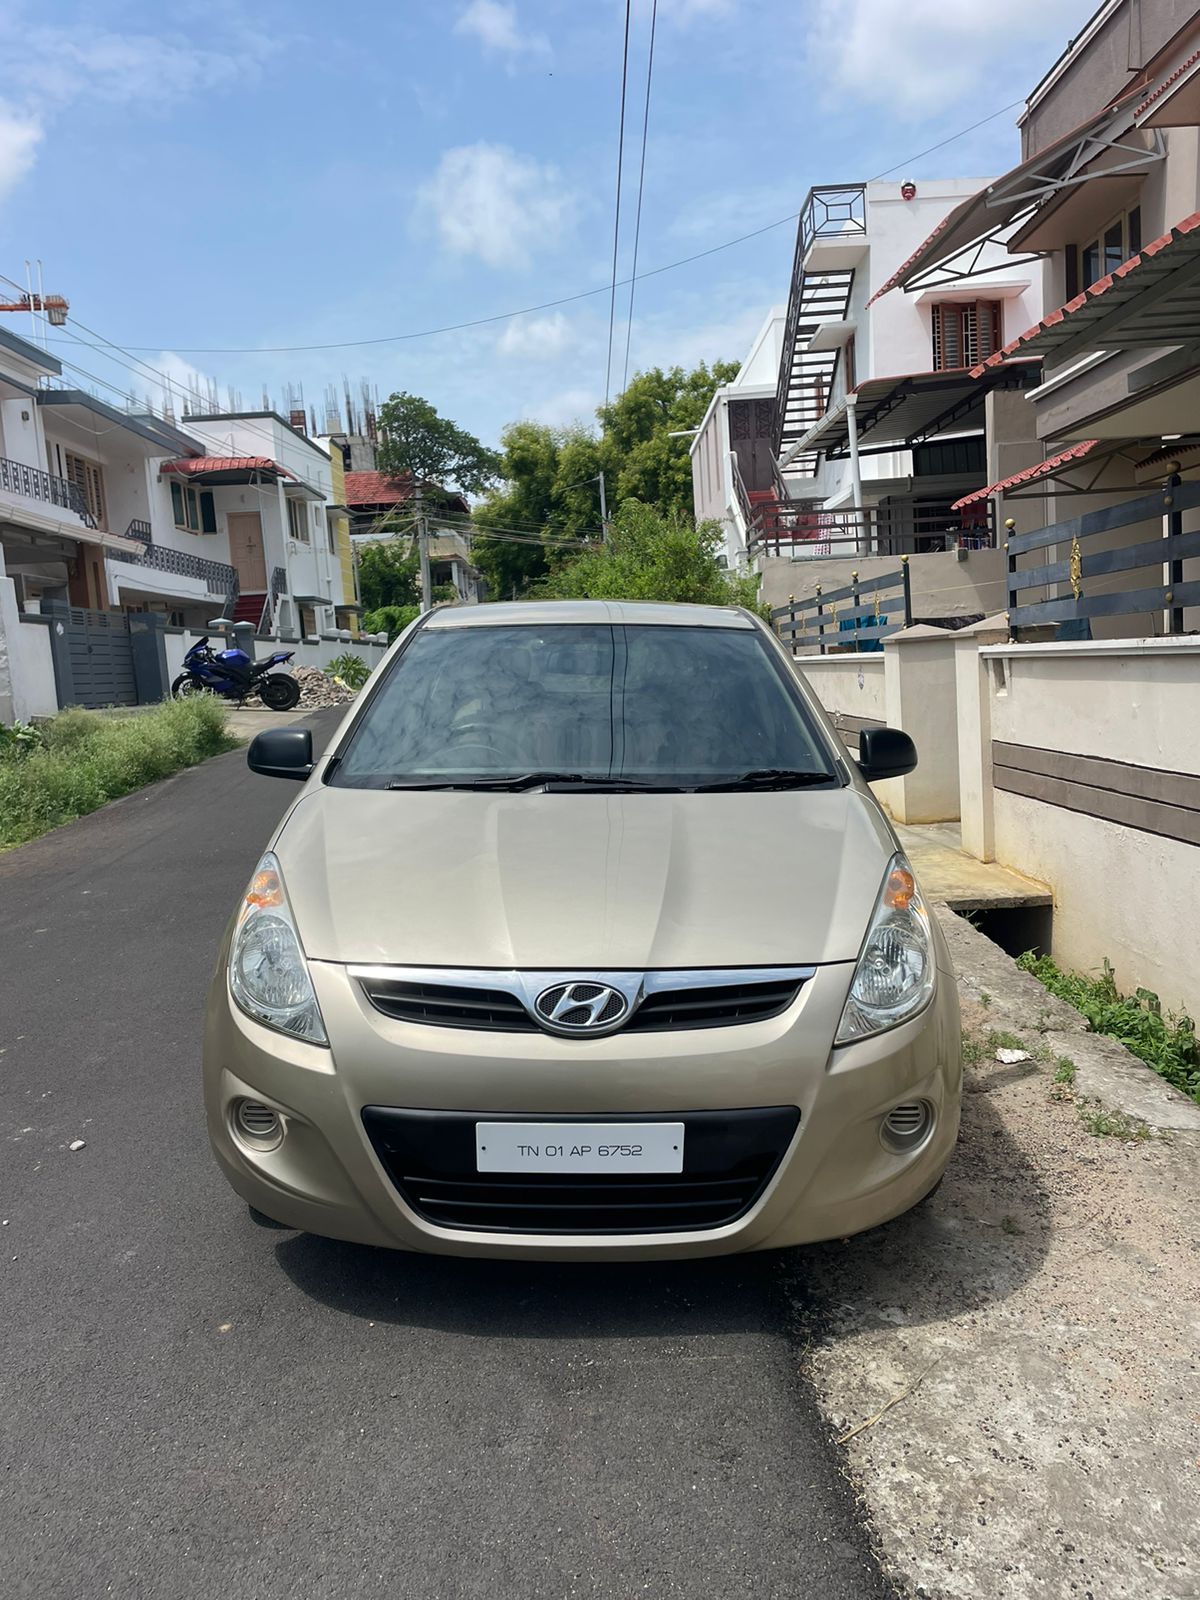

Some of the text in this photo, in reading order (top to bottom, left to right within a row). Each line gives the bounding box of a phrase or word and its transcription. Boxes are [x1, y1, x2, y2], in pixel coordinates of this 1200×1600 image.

[517, 1144, 643, 1157] TN 01 AP 6752
